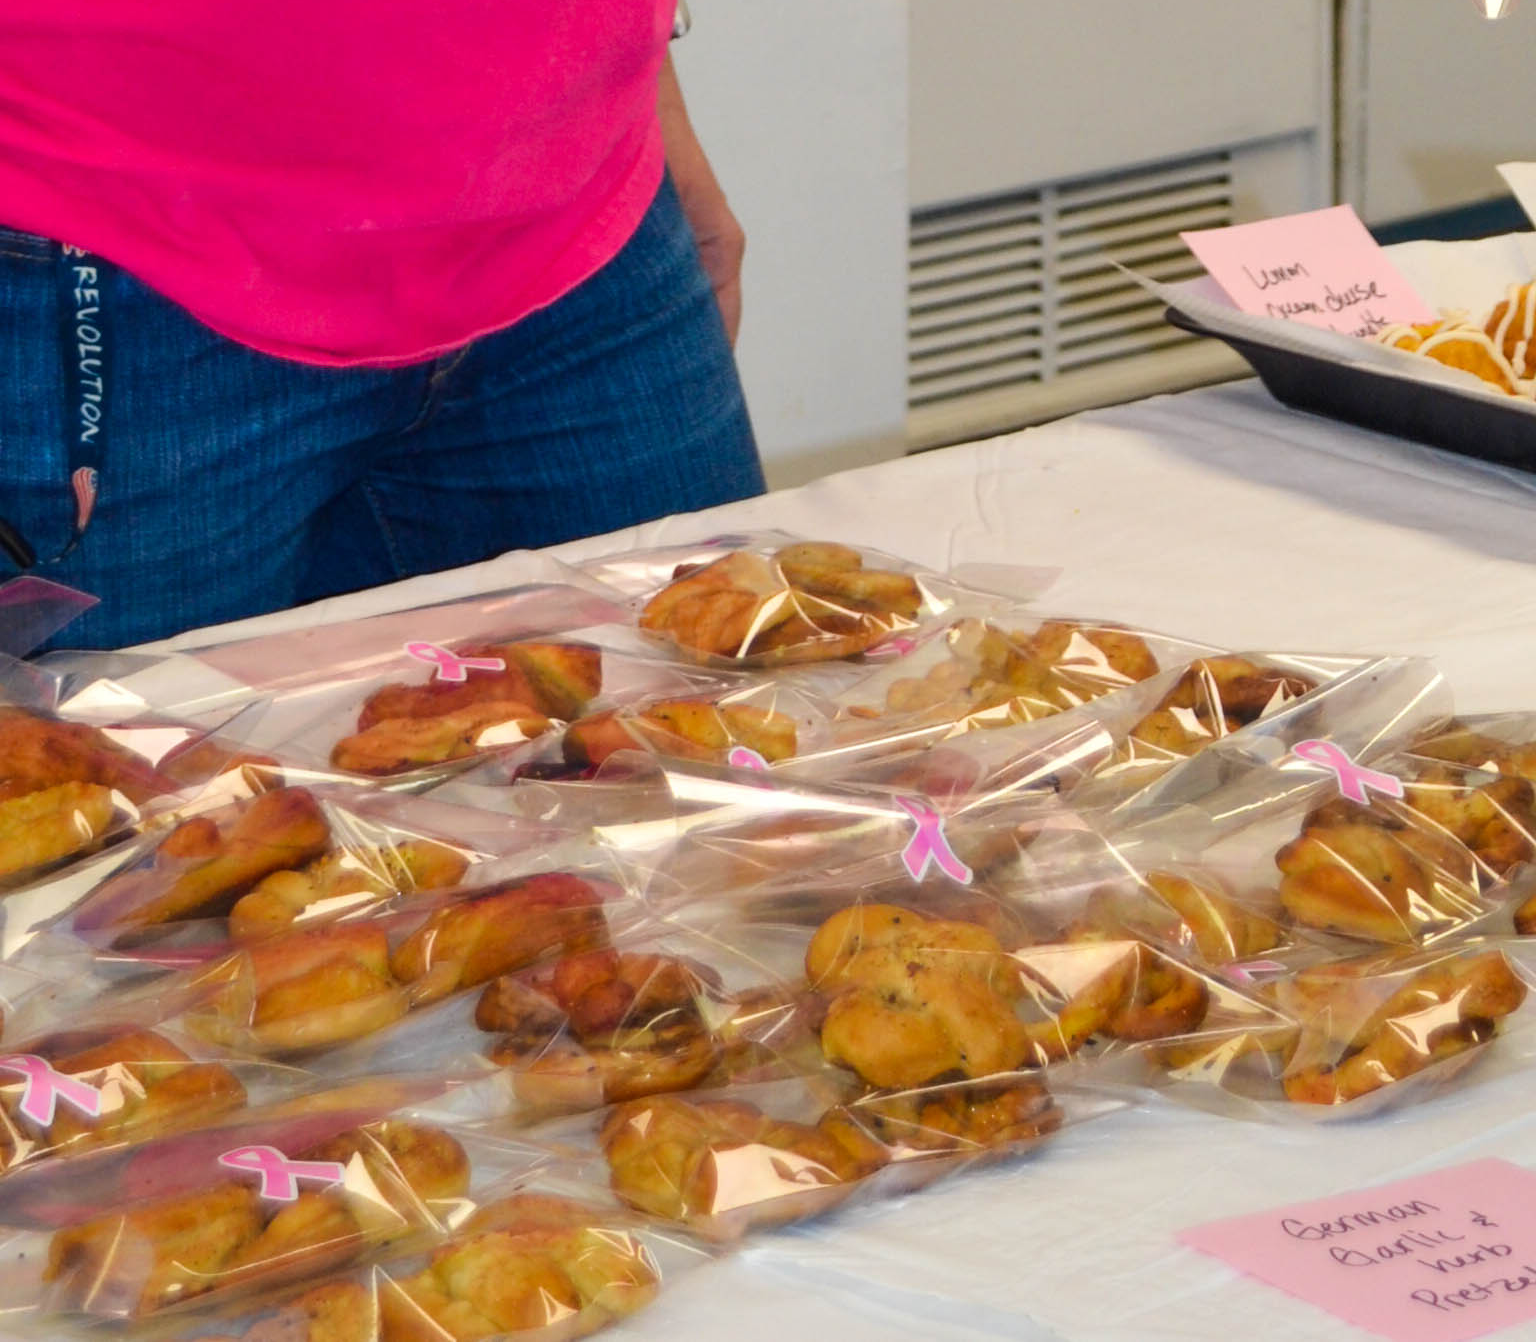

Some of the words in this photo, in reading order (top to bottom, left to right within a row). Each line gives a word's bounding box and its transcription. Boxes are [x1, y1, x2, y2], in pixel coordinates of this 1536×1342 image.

[72, 266, 103, 444] REVOLUTION
[1281, 1200, 1440, 1240] German
[1329, 1229, 1466, 1267] Garlic
[1416, 1244, 1513, 1274] herb
